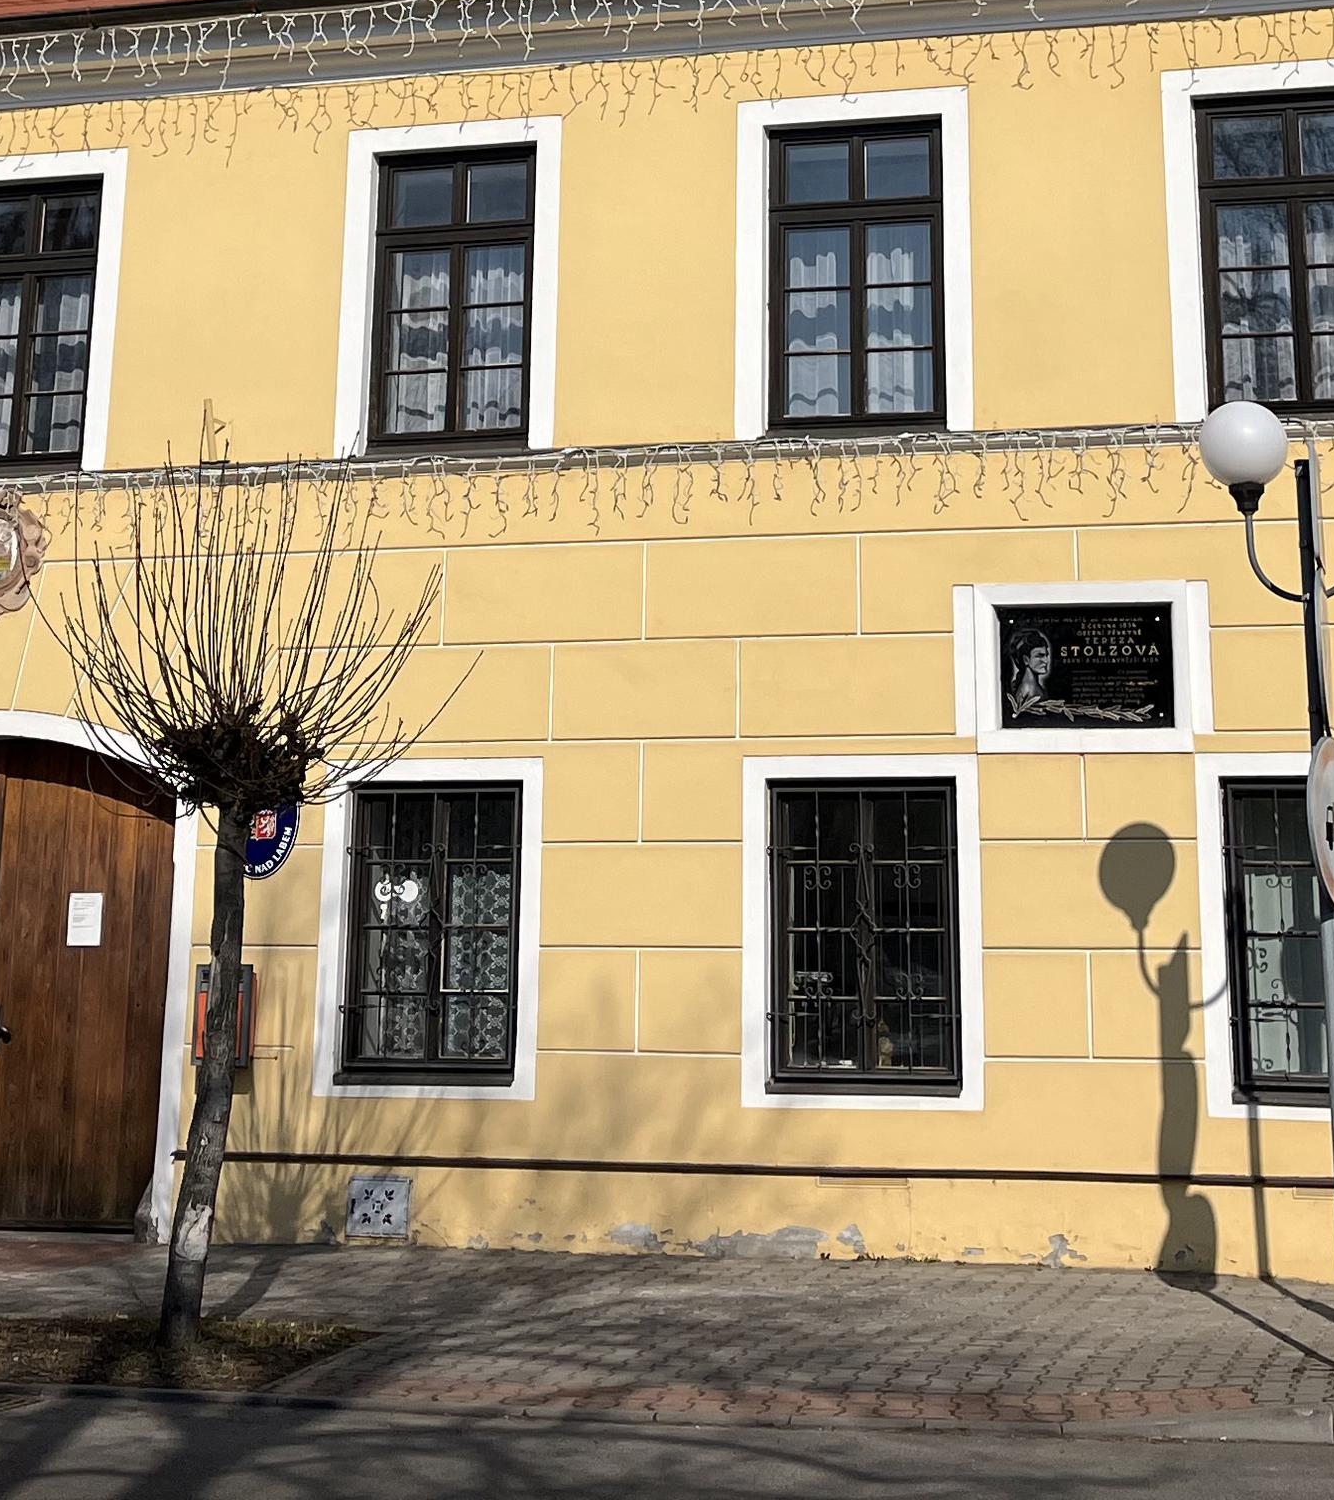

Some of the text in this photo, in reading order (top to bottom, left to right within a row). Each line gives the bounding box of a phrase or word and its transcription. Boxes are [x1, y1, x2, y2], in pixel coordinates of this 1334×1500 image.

[1084, 636, 1135, 645] TEREZA
[1060, 642, 1160, 657] STOLZOVÁ
[254, 826, 293, 874] NAD LABEM
